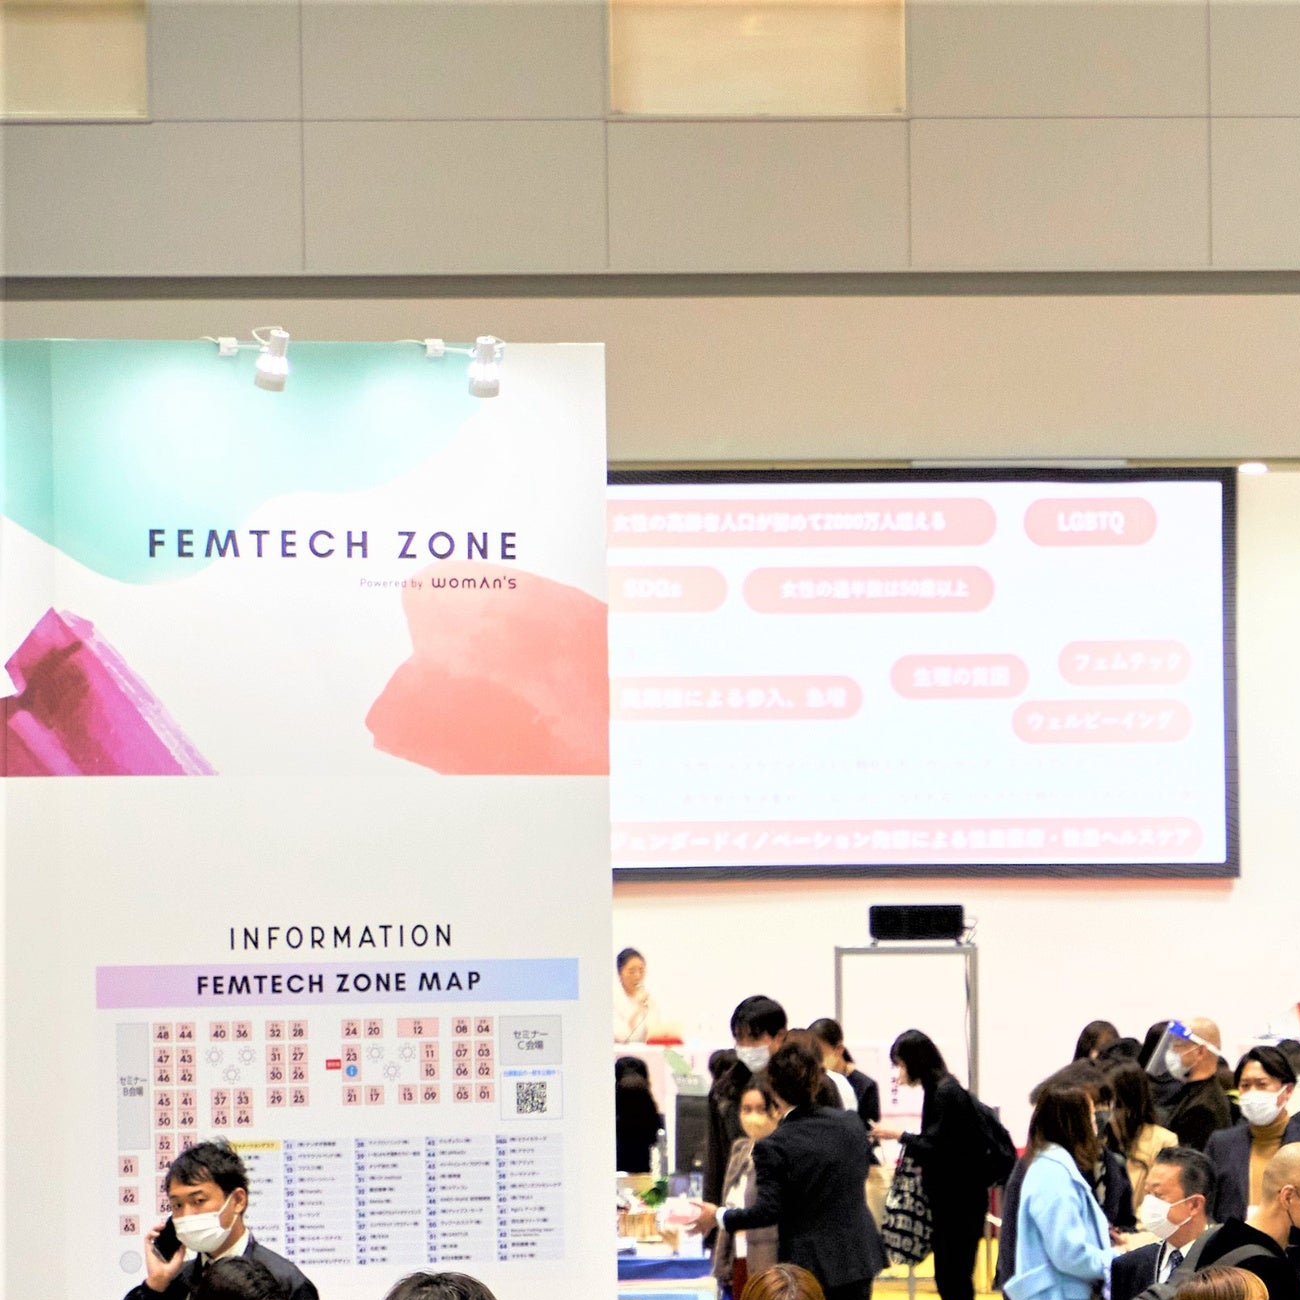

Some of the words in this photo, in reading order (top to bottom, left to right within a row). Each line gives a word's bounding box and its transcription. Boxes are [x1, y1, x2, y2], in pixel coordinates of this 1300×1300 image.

[1057, 511, 1126, 533] LGBTQ
[149, 529, 367, 558] FEMTECH
[398, 532, 515, 559] ZONE
[360, 579, 408, 591] Powered
[411, 579, 422, 590] by
[622, 579, 682, 599] SDGs
[1074, 652, 1182, 673] フェムテック
[1026, 711, 1174, 732] ウェルビーイング
[231, 925, 450, 949] INFORMATION
[198, 975, 322, 994] FEMTECH
[337, 973, 405, 992] ZONE
[419, 972, 480, 990] MAP
[517, 1041, 543, 1049] C会場
